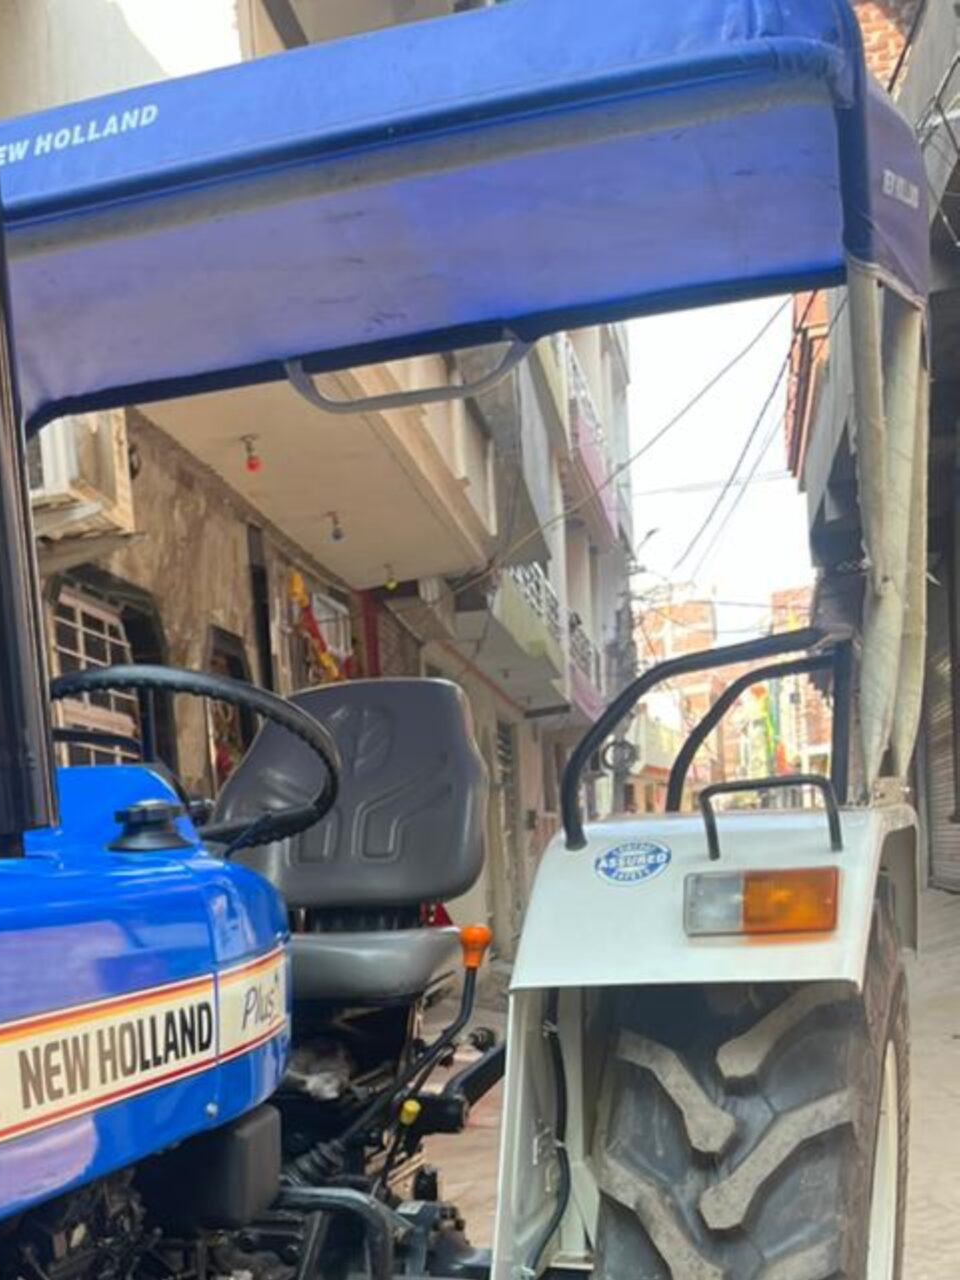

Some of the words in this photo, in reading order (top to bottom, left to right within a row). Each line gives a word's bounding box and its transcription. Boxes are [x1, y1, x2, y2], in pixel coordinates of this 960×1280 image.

[33, 104, 158, 158] HOLLAND
[18, 1033, 90, 1110] NEW
[96, 1001, 214, 1085] HOLLAND
